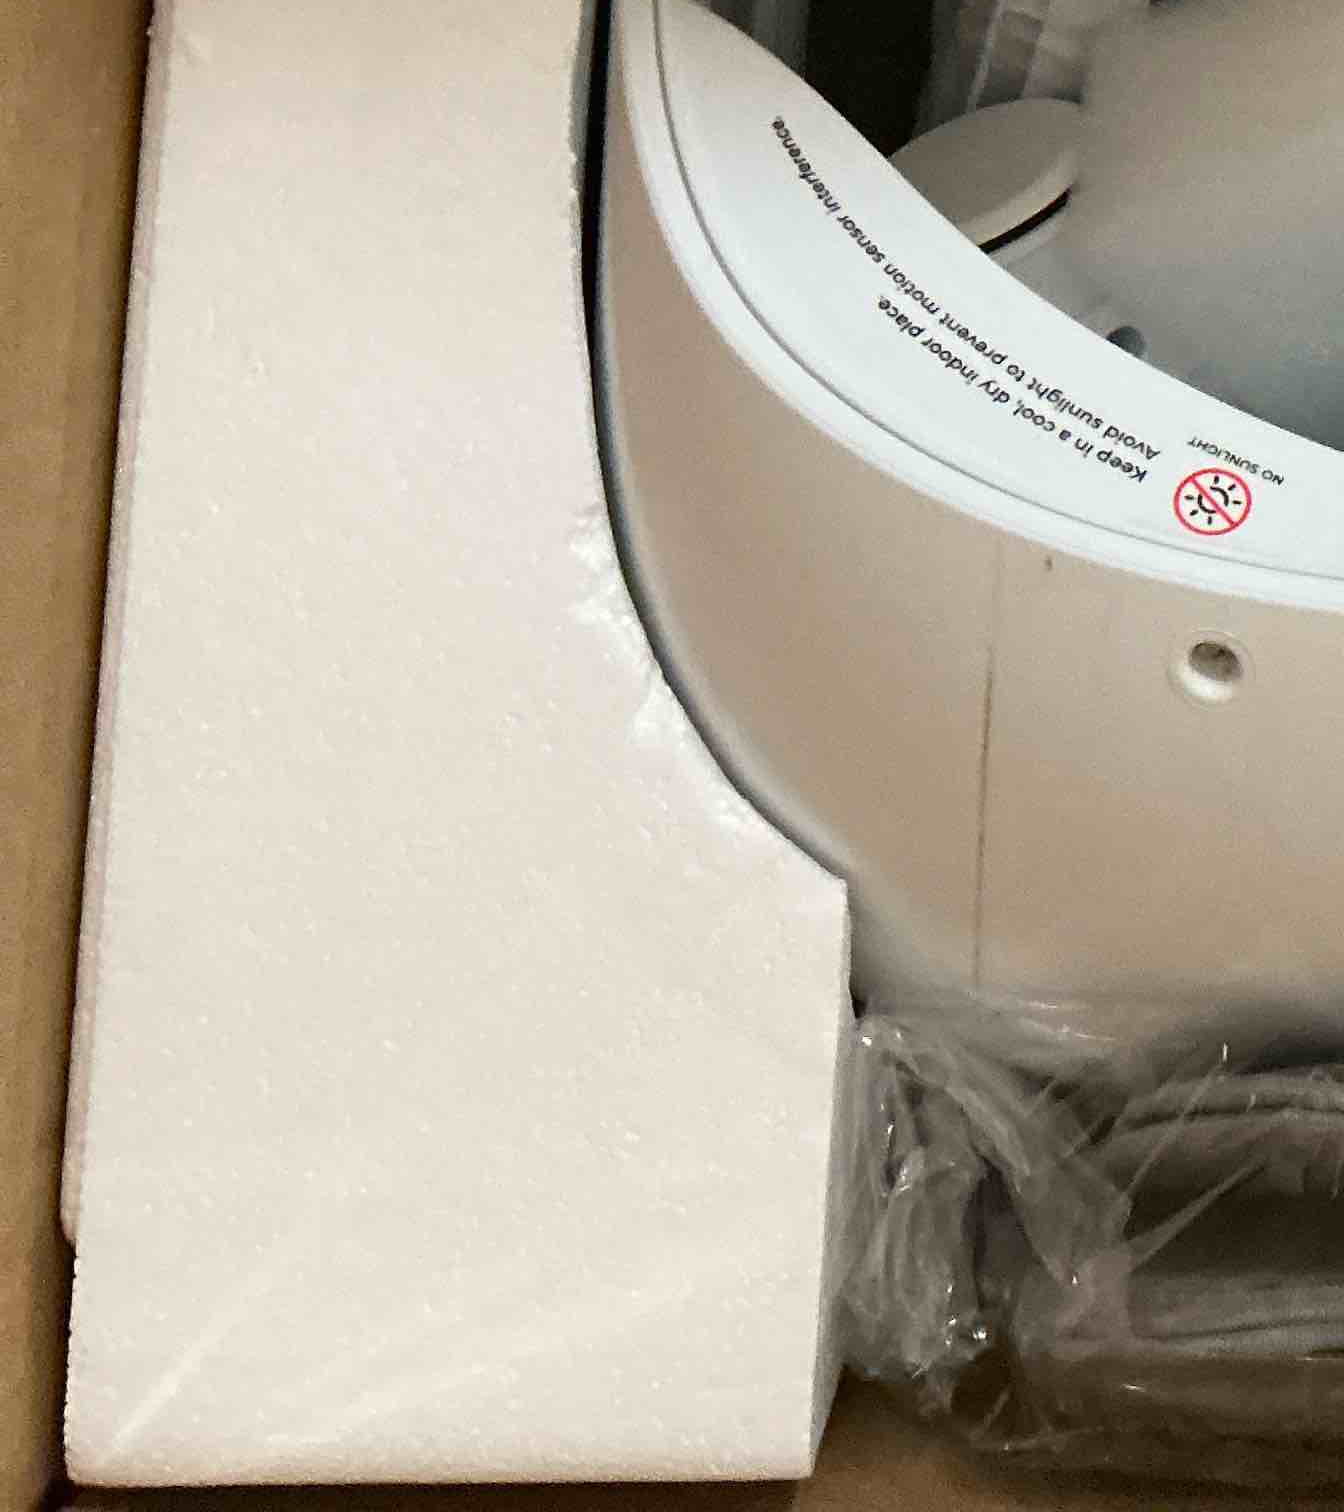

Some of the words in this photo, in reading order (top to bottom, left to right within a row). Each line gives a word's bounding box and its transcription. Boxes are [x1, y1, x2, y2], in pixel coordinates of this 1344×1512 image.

[771, 116, 841, 213] interference.
[836, 215, 886, 264] sensor
[883, 263, 941, 315] motion
[878, 295, 926, 338] place.
[938, 312, 1009, 365] prevent
[920, 337, 980, 385] indoor
[1006, 364, 1026, 383] to
[977, 380, 1011, 404] dry
[1026, 377, 1104, 430] sunlight
[1012, 399, 1056, 432] cool,
[1058, 429, 1072, 441] a
[1074, 438, 1094, 458] in
[1102, 425, 1161, 461] Avoid
[1096, 450, 1148, 483] Keep
[1187, 437, 1260, 474] SUNLIGHT
[1261, 469, 1285, 486] NO
